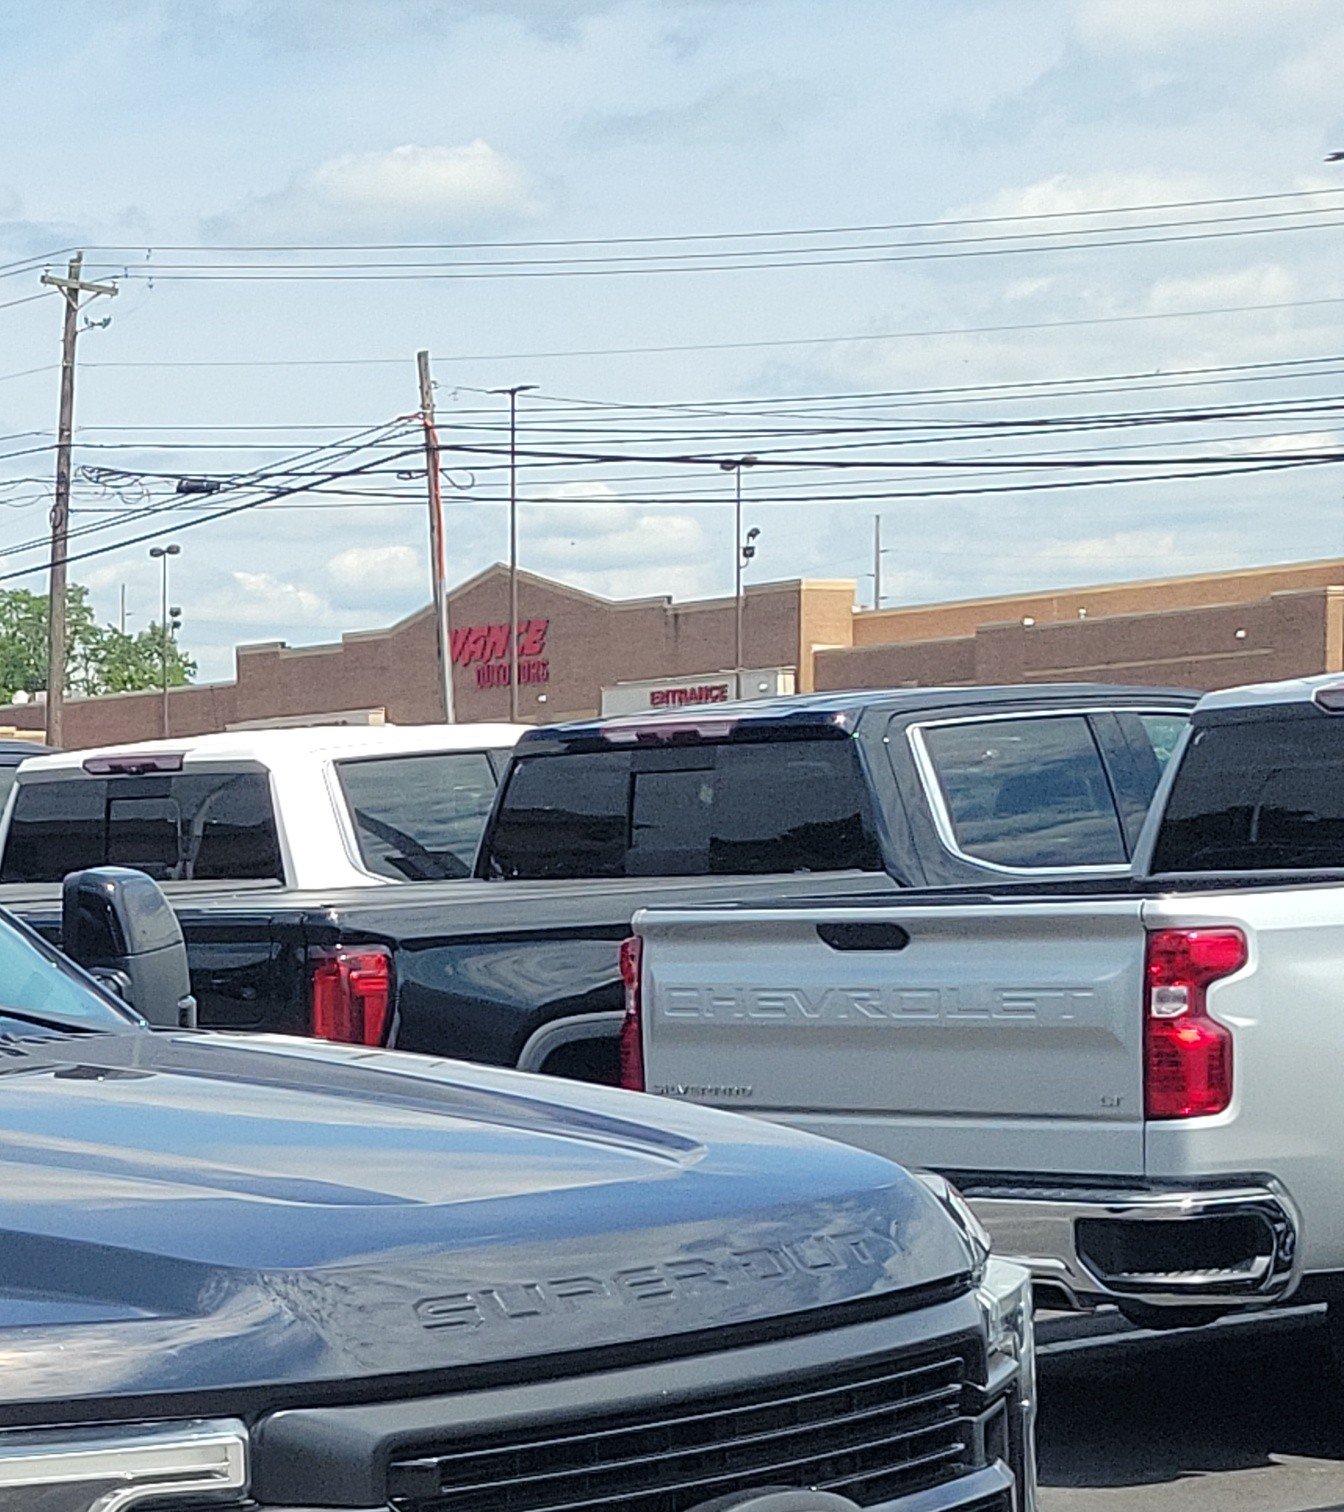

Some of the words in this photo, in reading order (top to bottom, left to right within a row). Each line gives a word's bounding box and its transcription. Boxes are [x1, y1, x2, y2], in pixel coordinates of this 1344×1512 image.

[650, 684, 728, 706] ENTRANCE
[664, 986, 1094, 1020] CHEVROLET
[412, 1257, 728, 1331] SUPER
[732, 1219, 905, 1280] DUTY
